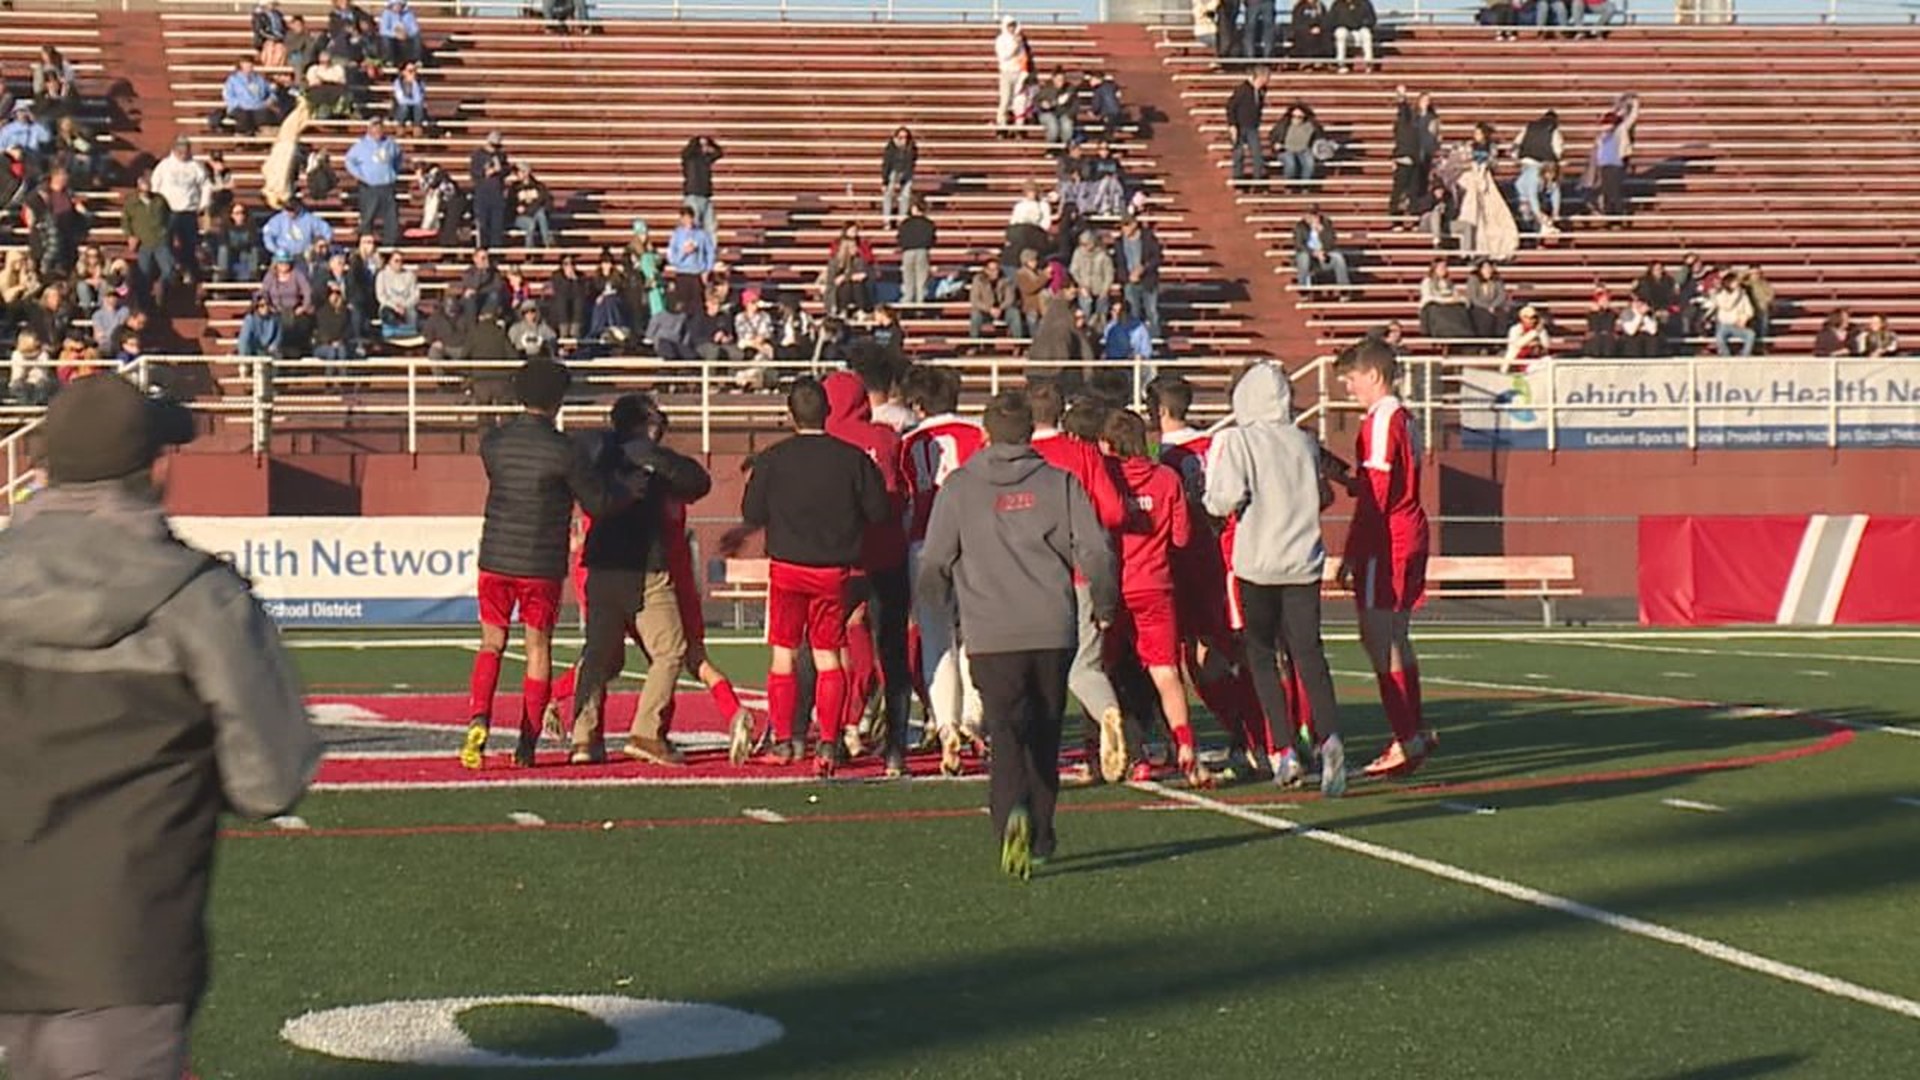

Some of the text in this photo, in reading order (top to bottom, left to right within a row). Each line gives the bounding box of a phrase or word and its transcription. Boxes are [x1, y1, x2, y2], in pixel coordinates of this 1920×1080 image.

[1553, 381, 1658, 417] ehigh
[311, 539, 474, 576] Networ
[312, 601, 362, 617] District
